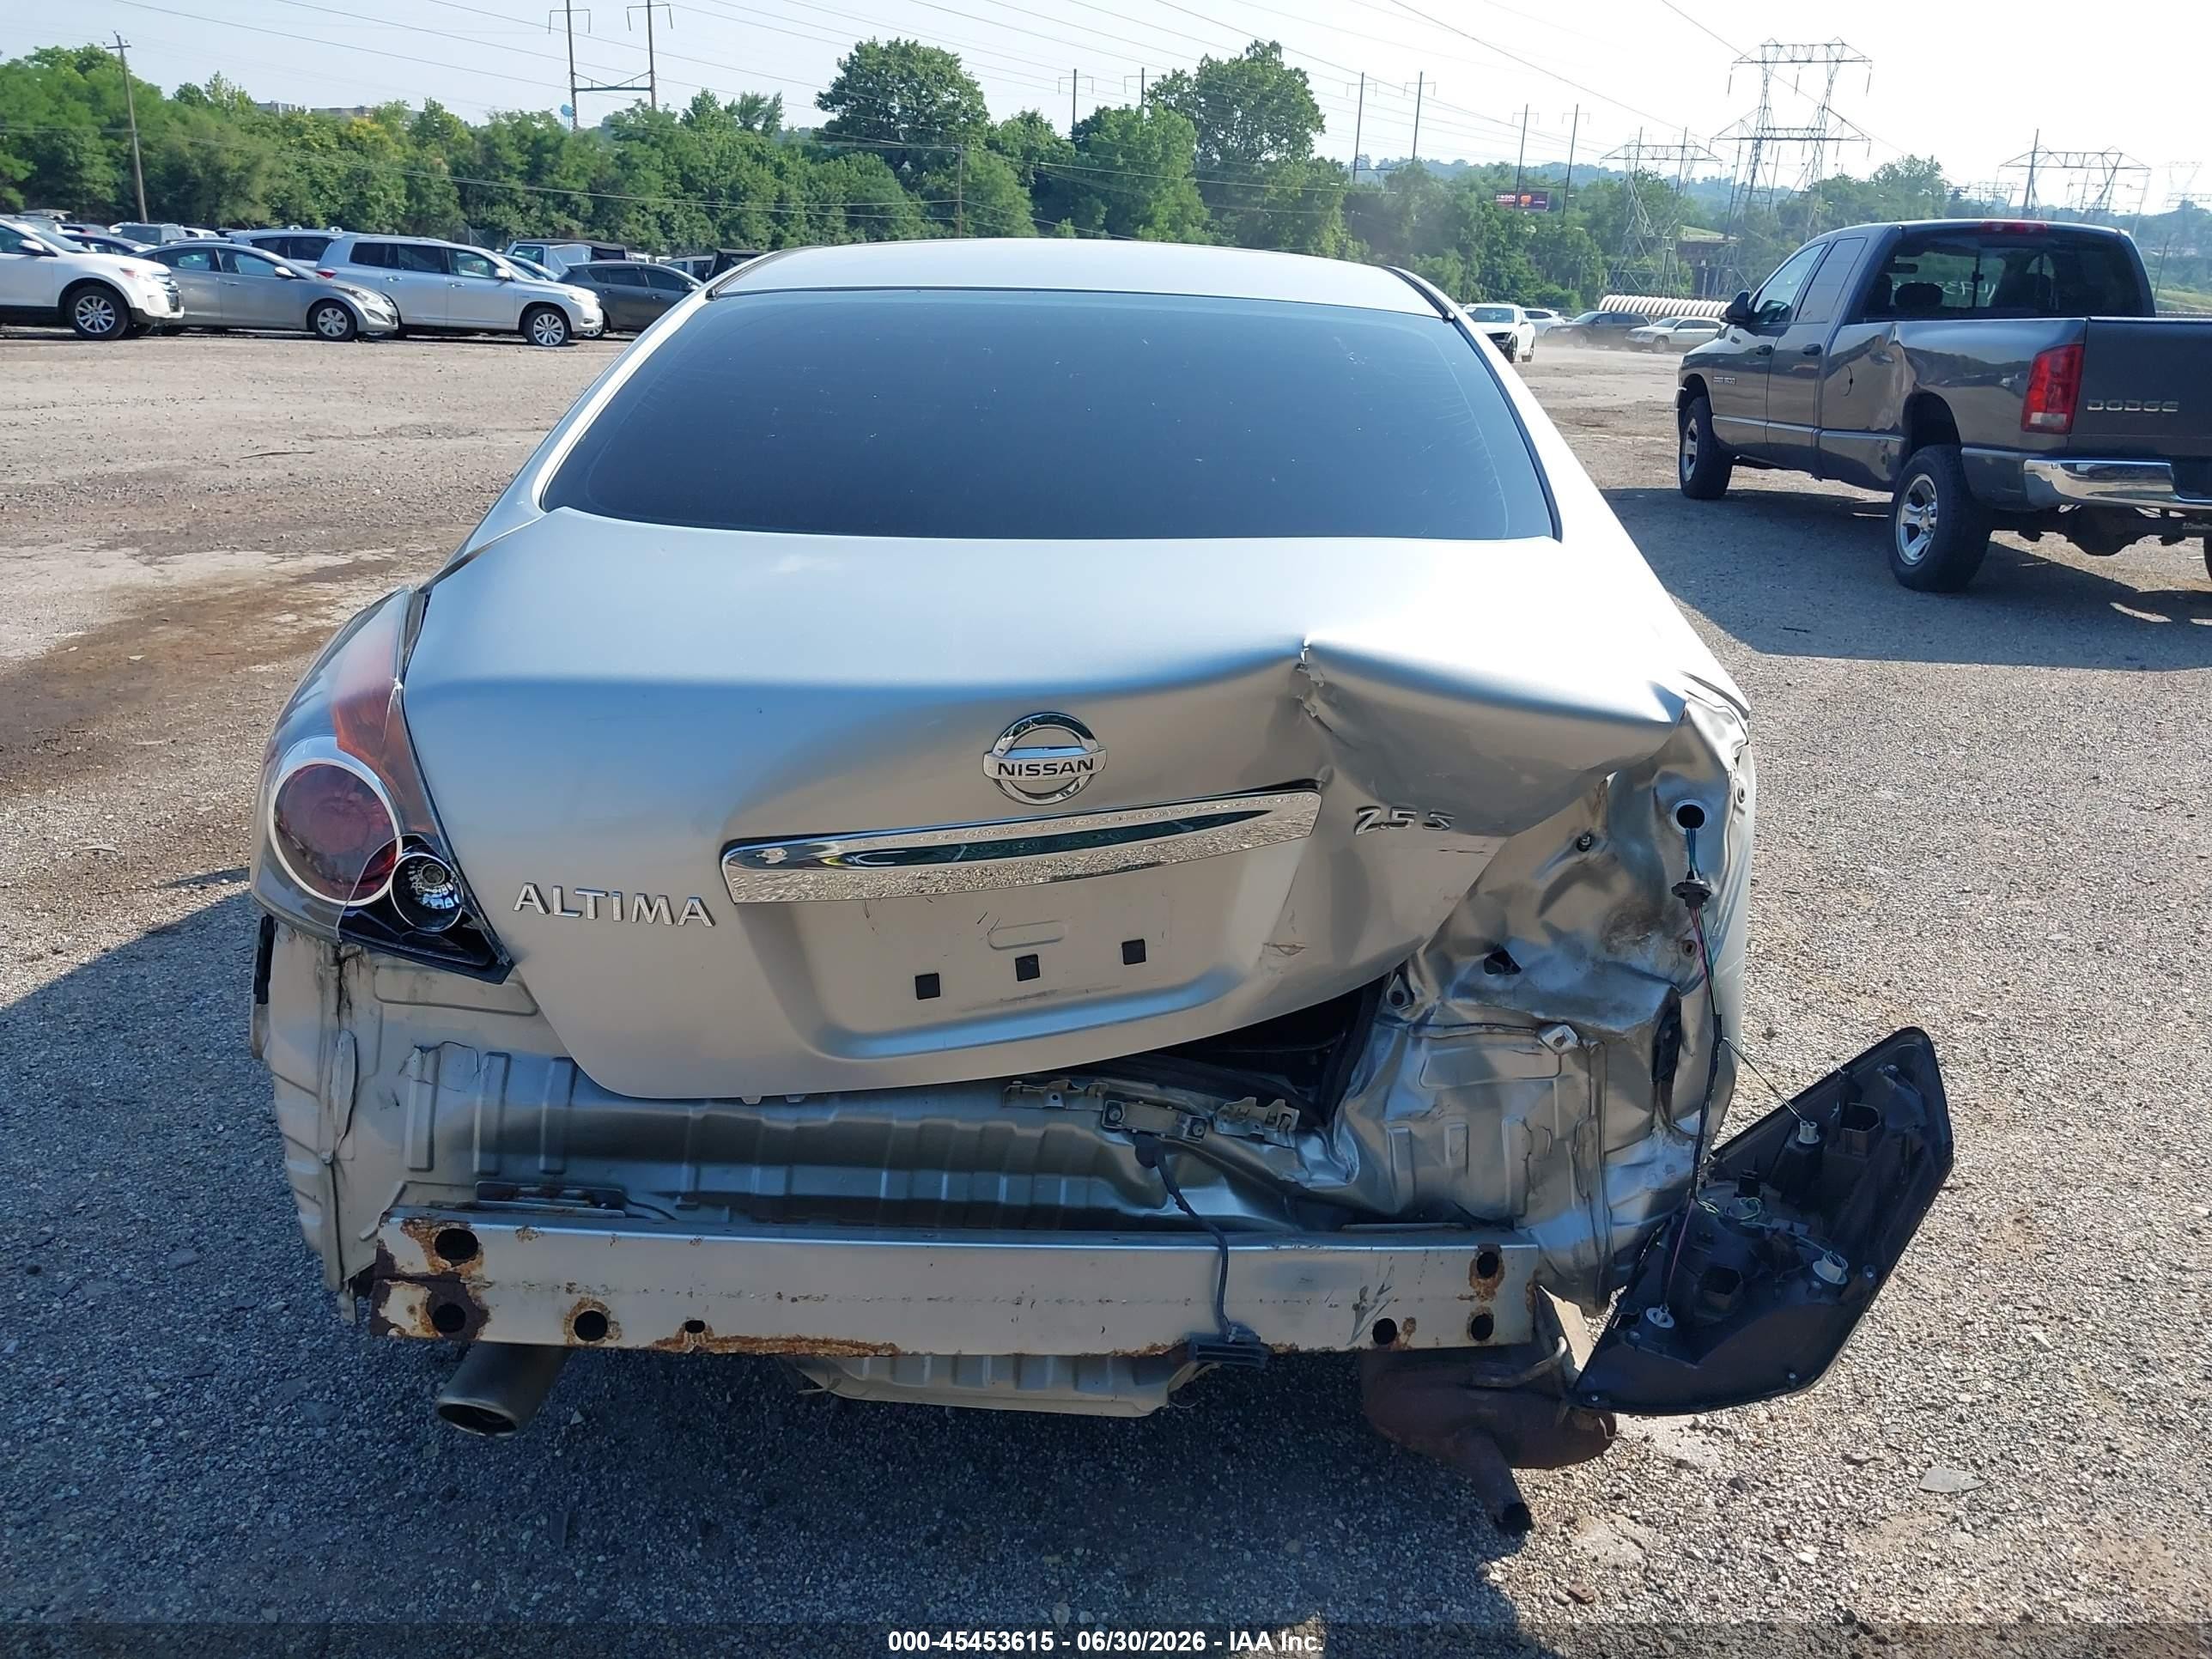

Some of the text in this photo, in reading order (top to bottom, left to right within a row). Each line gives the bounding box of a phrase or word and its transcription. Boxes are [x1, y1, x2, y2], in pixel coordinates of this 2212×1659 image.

[2087, 398, 2179, 412] DODGE
[997, 757, 1095, 777] NISSAN
[1354, 805, 1455, 836] 2.5 S
[513, 882, 716, 928] ALTIMA
